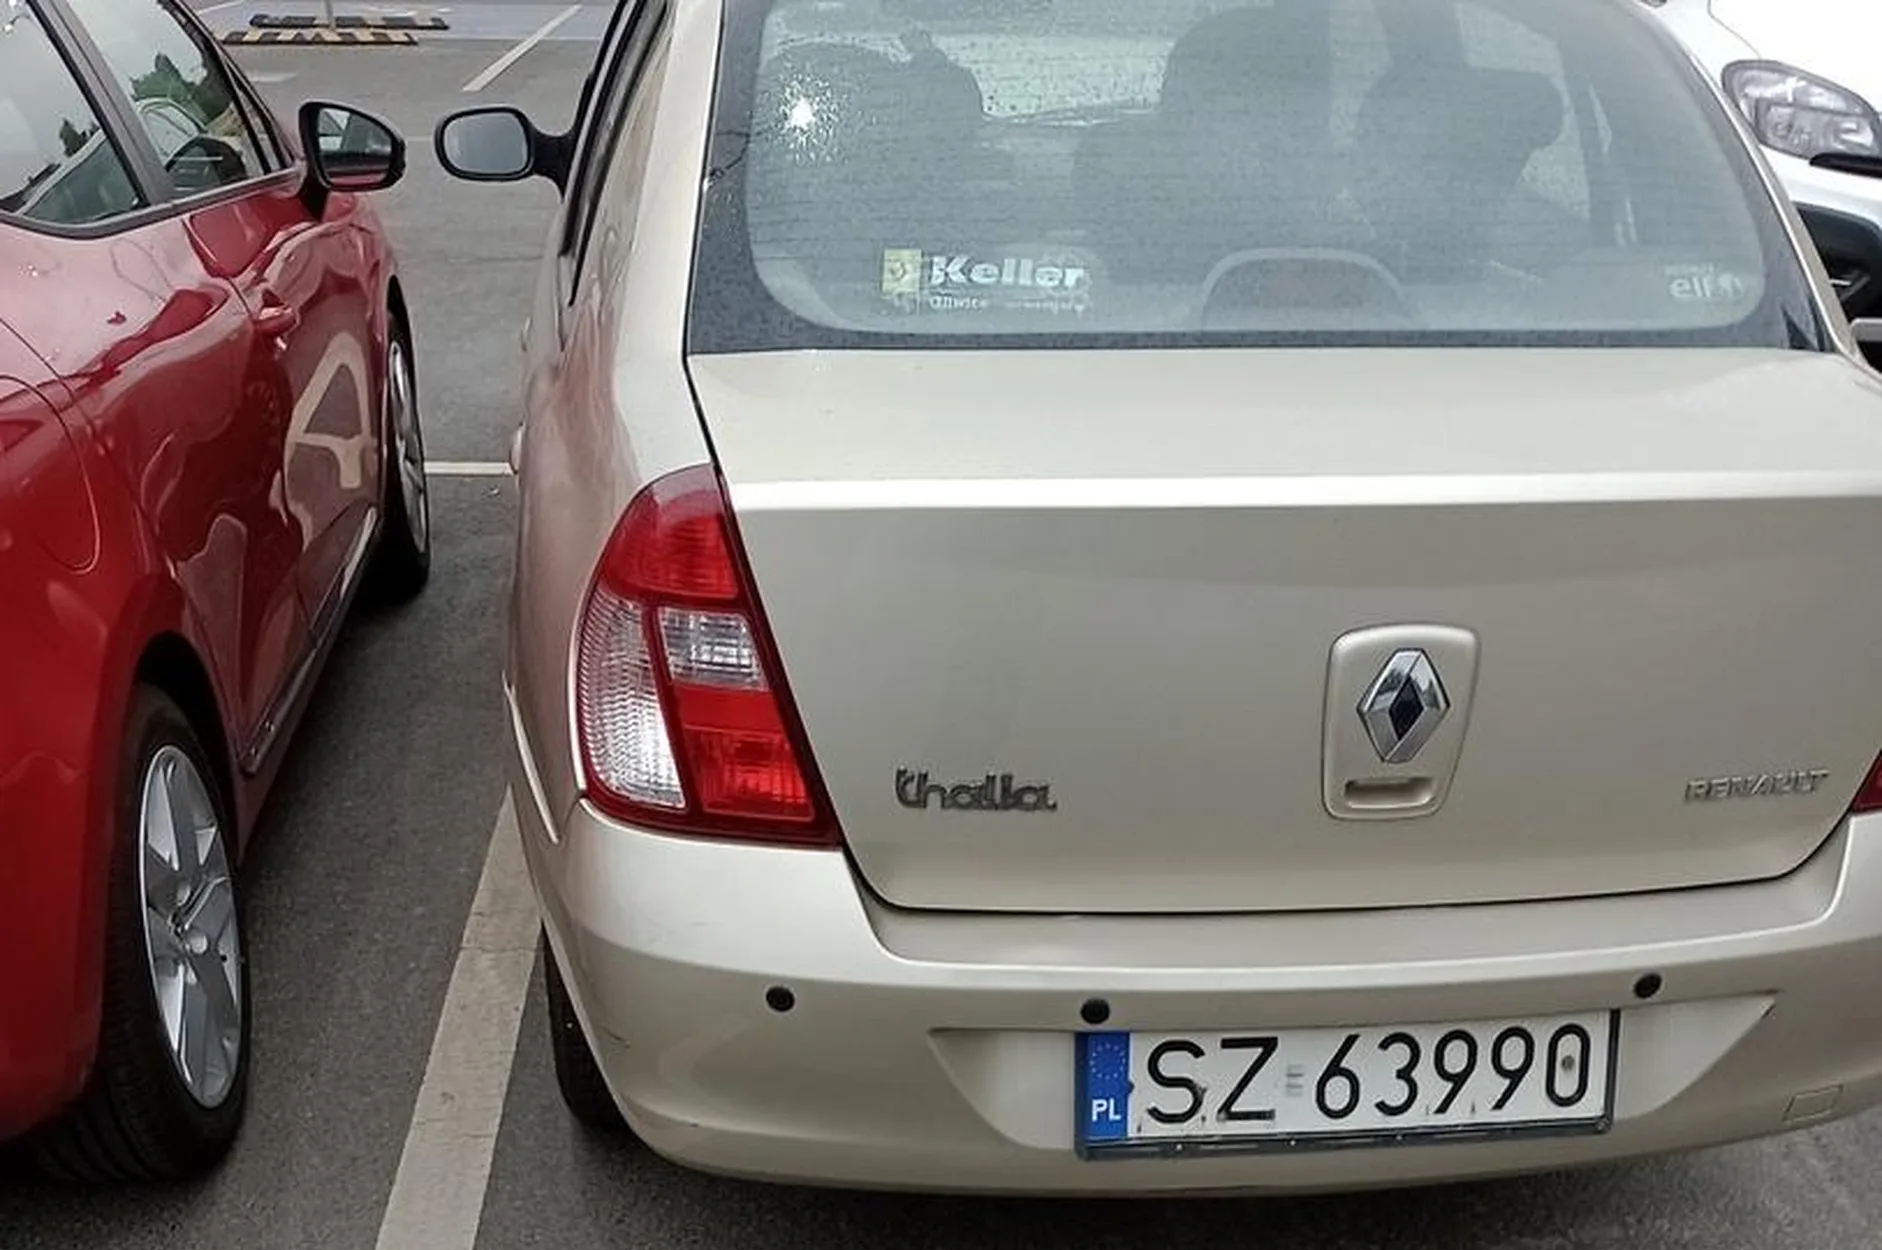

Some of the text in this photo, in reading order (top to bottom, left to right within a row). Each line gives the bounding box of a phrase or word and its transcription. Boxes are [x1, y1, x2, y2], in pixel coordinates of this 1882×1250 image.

[931, 255, 1086, 287] Keller
[1685, 769, 1831, 802] RENAULT
[1146, 1023, 1592, 1124] SZ 63990
[1091, 1100, 1122, 1121] PL
